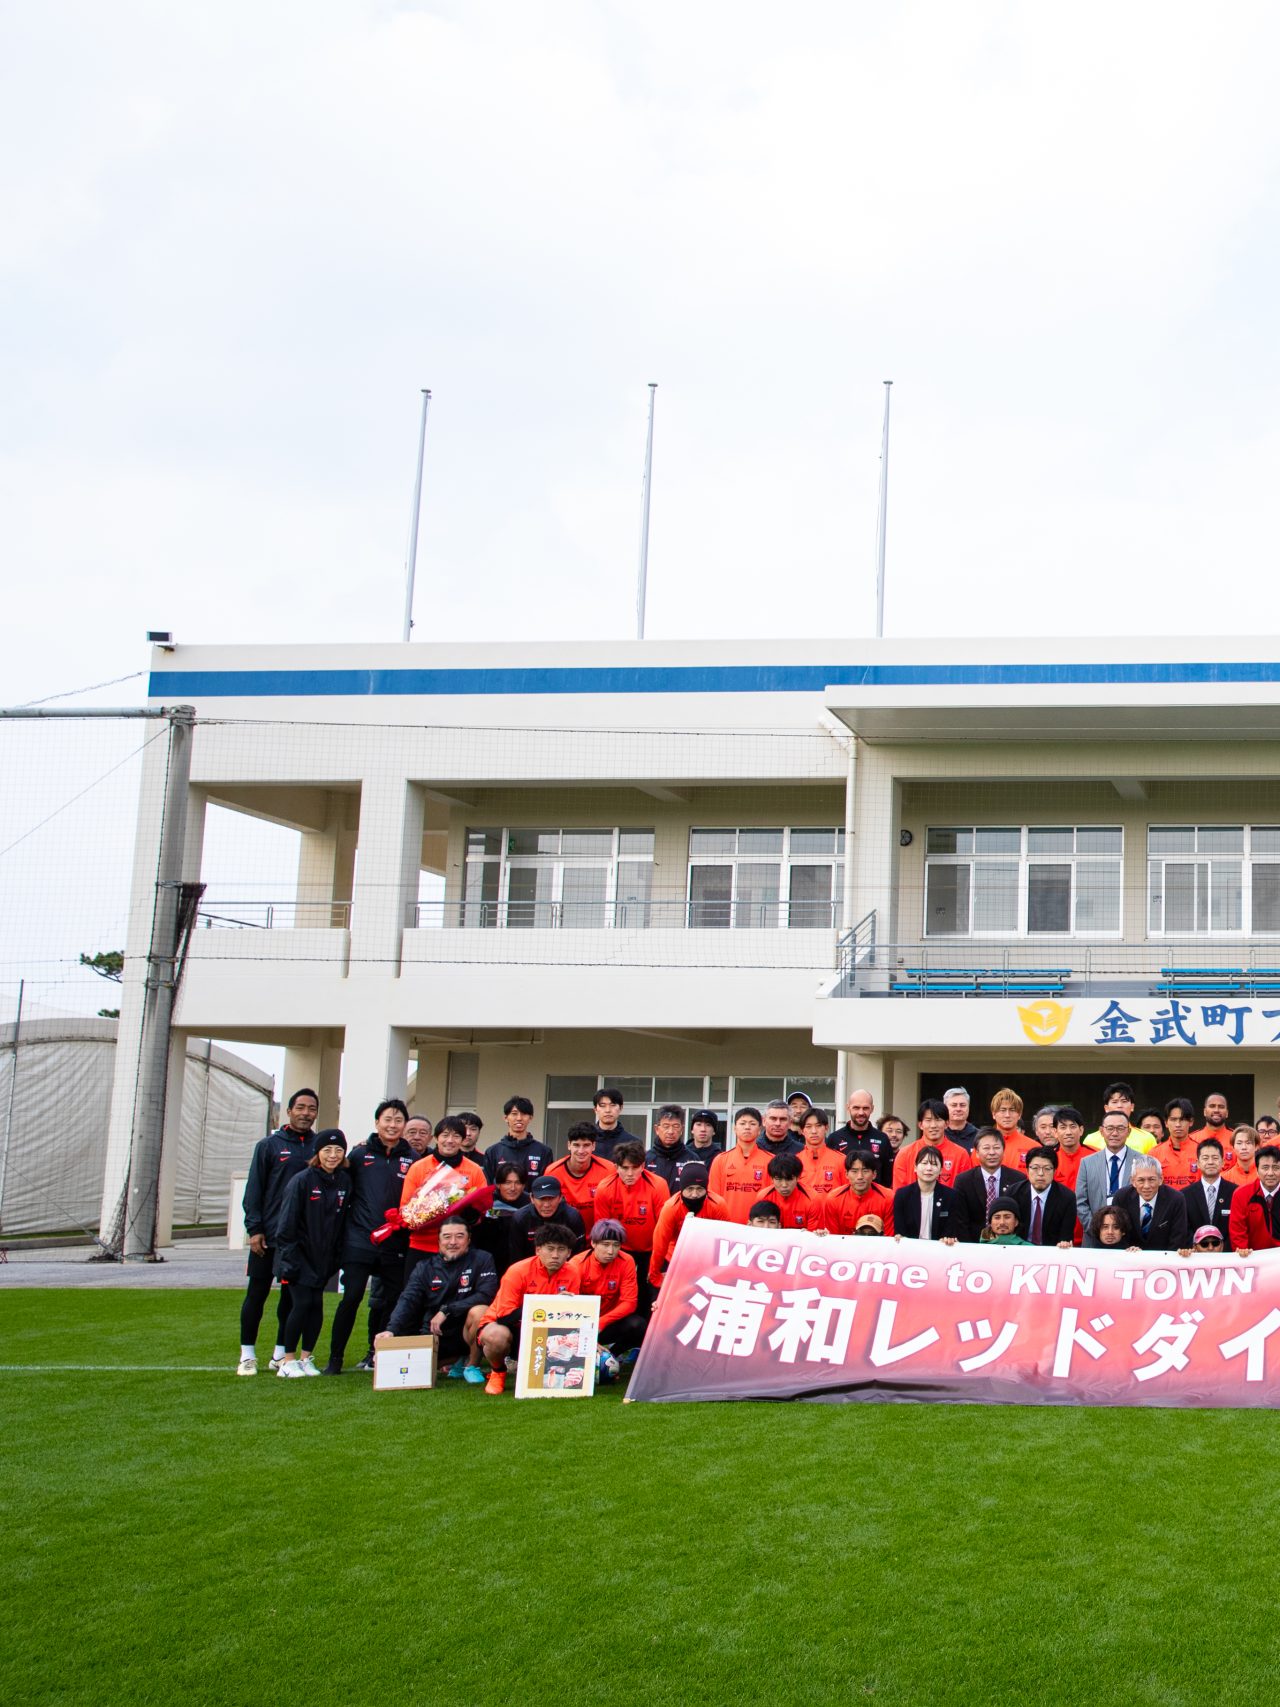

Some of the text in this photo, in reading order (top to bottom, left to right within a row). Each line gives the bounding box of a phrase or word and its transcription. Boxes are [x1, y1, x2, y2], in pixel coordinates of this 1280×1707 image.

[718, 1239, 1255, 1301] Welcome to KIN TOWN
